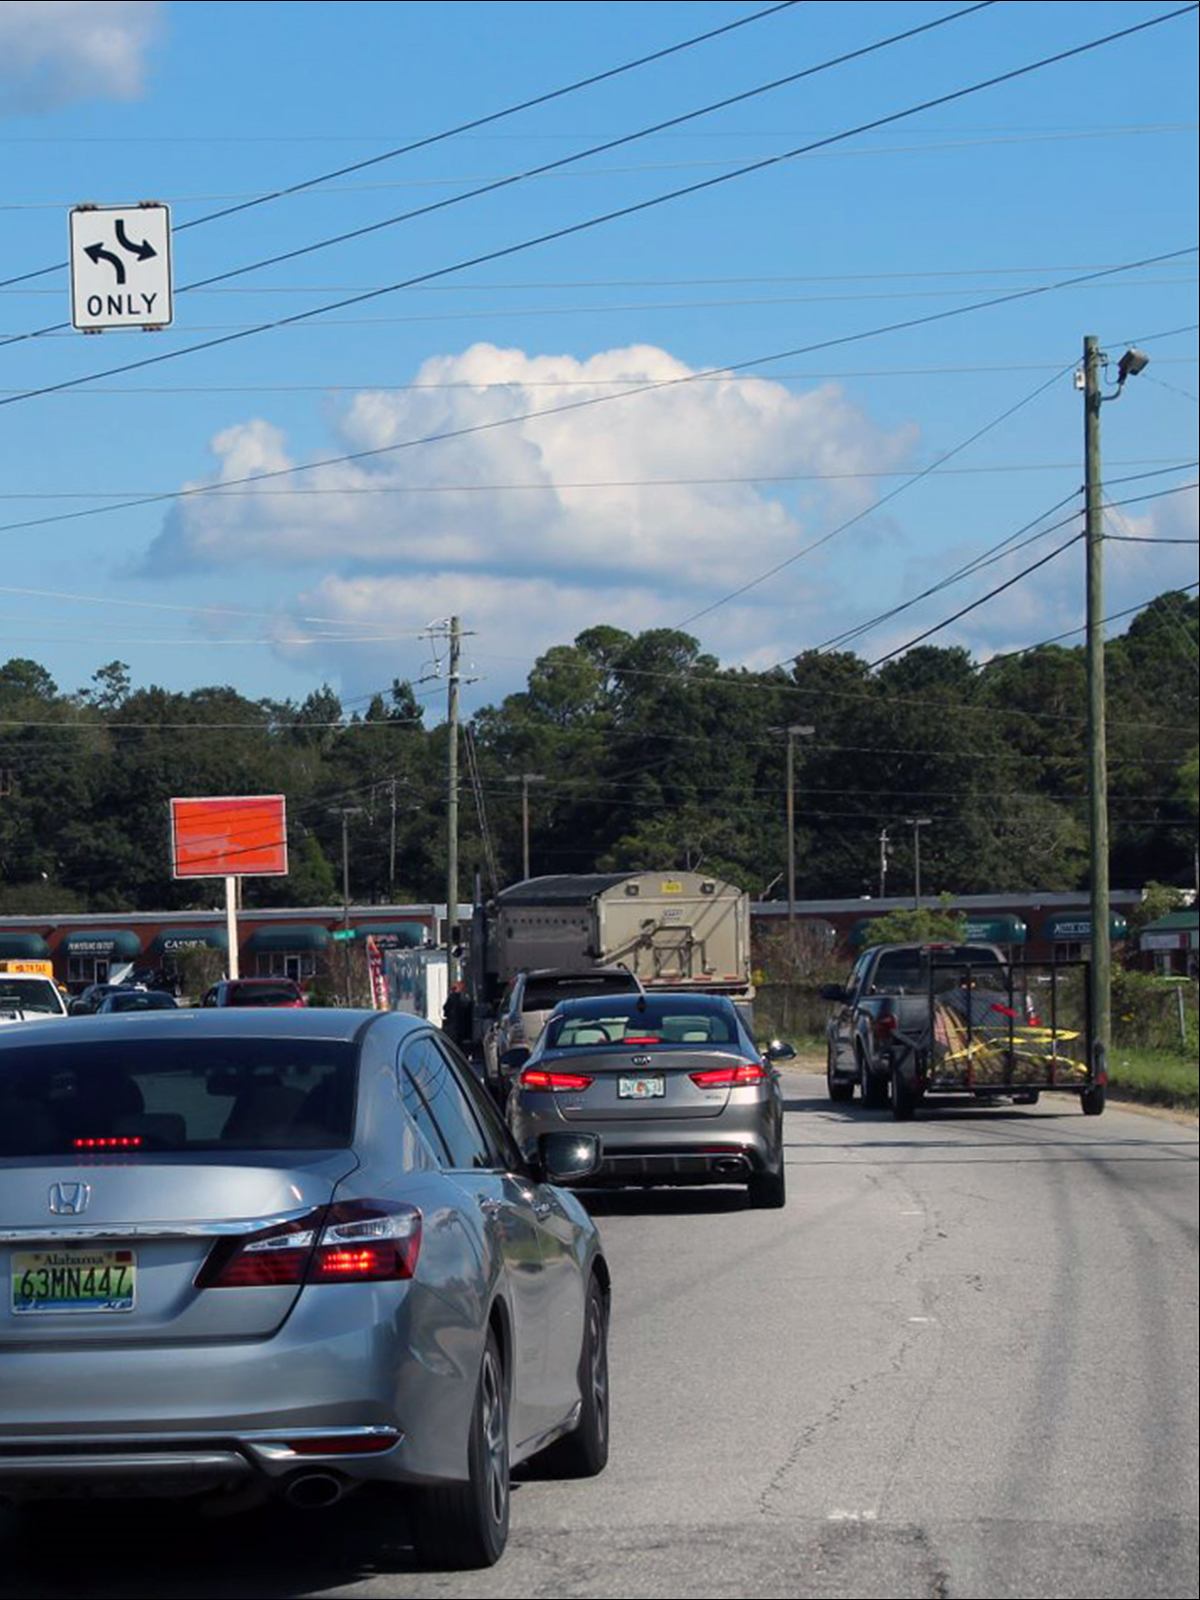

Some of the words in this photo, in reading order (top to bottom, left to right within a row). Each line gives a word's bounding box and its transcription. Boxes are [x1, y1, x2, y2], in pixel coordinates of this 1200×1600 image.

[87, 292, 158, 317] ONLY
[44, 1252, 104, 1266] Alabama
[20, 1265, 128, 1299] 63MN447
